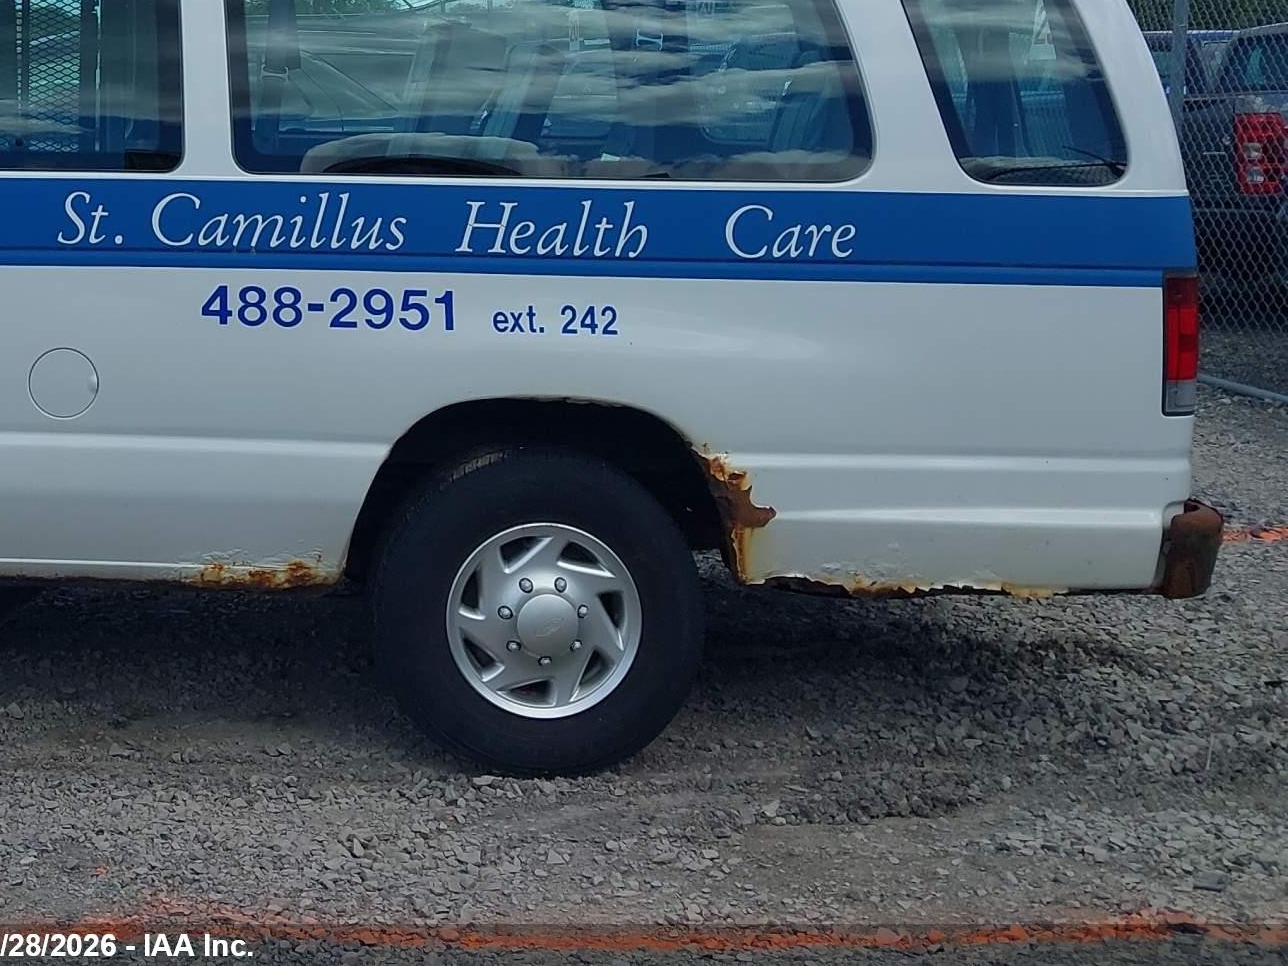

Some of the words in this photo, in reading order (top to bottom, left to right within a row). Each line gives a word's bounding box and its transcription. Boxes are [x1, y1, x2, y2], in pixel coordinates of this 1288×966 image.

[57, 191, 124, 245] St.
[151, 192, 407, 251] Camillus
[455, 200, 648, 258] Health
[725, 204, 856, 259] Care
[200, 284, 455, 331] 488-2951
[492, 305, 545, 334] ext.
[560, 305, 618, 335] 242
